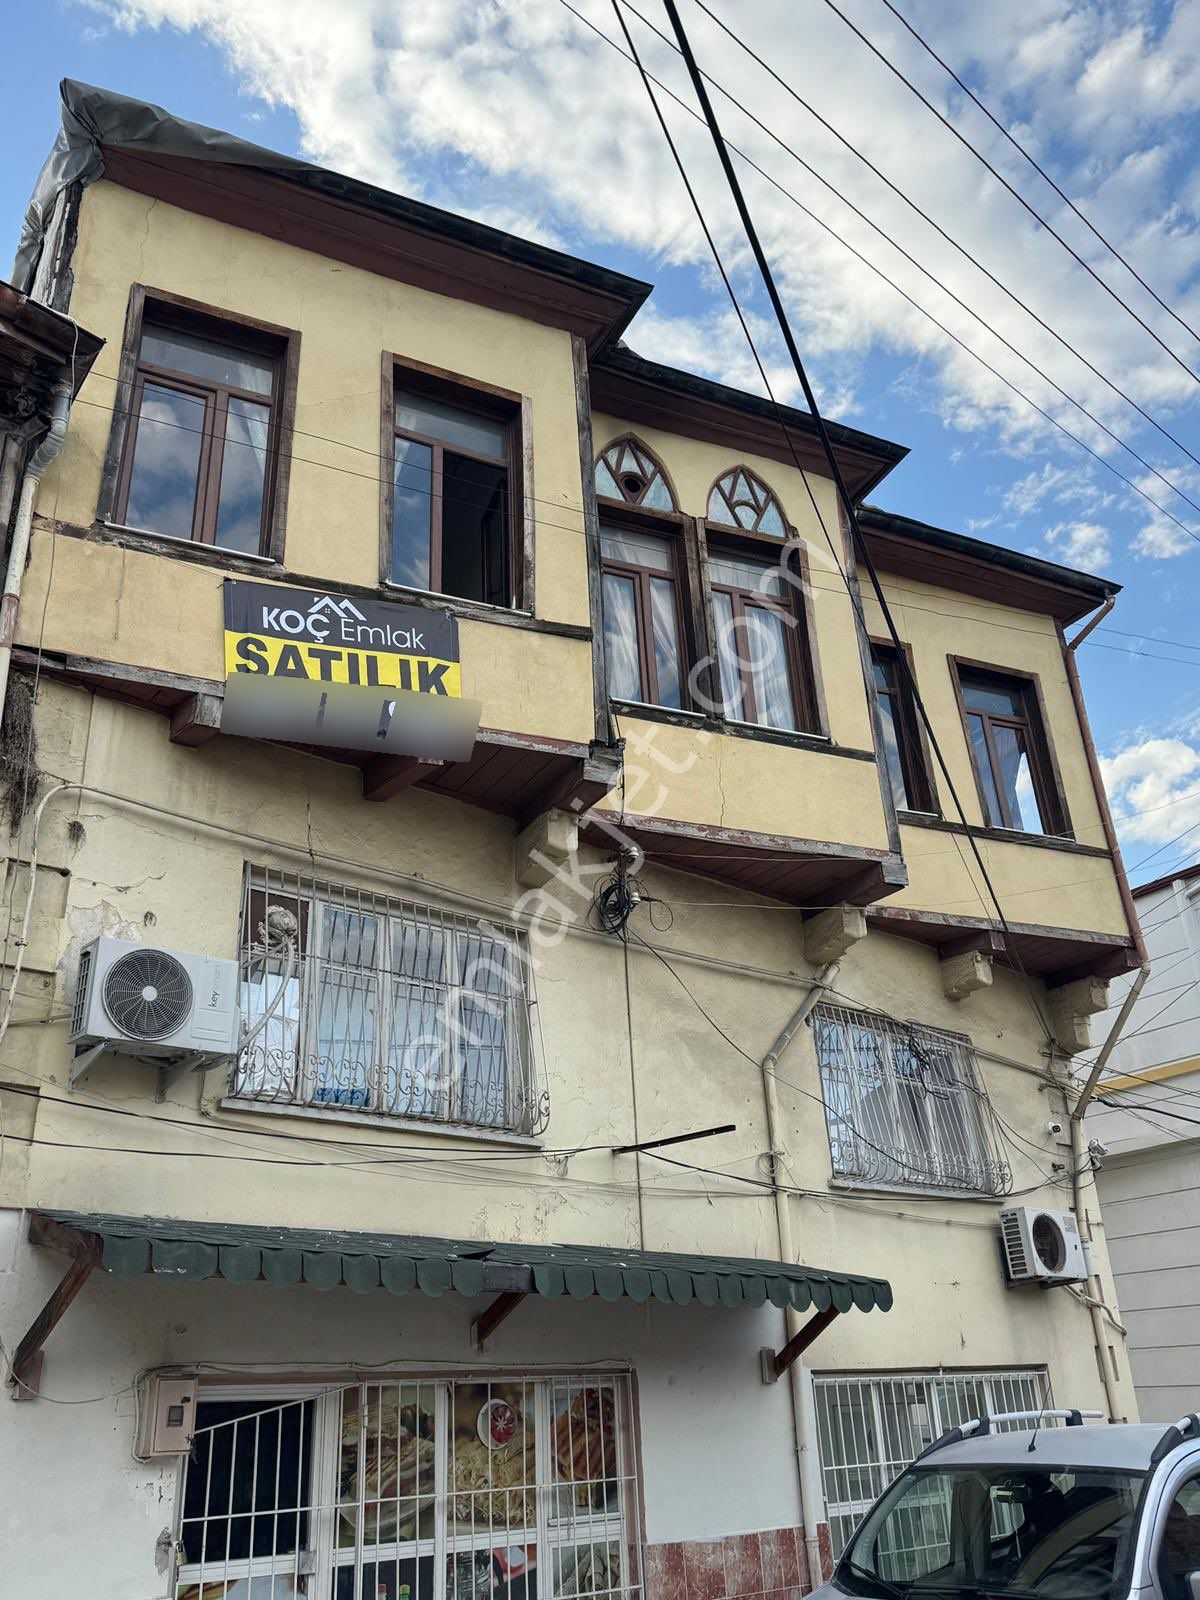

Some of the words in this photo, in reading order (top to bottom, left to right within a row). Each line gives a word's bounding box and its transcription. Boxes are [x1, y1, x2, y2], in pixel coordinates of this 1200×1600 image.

[262, 606, 330, 644] KOÇ
[341, 618, 426, 650] Emlak
[236, 637, 451, 697] SATILIK
